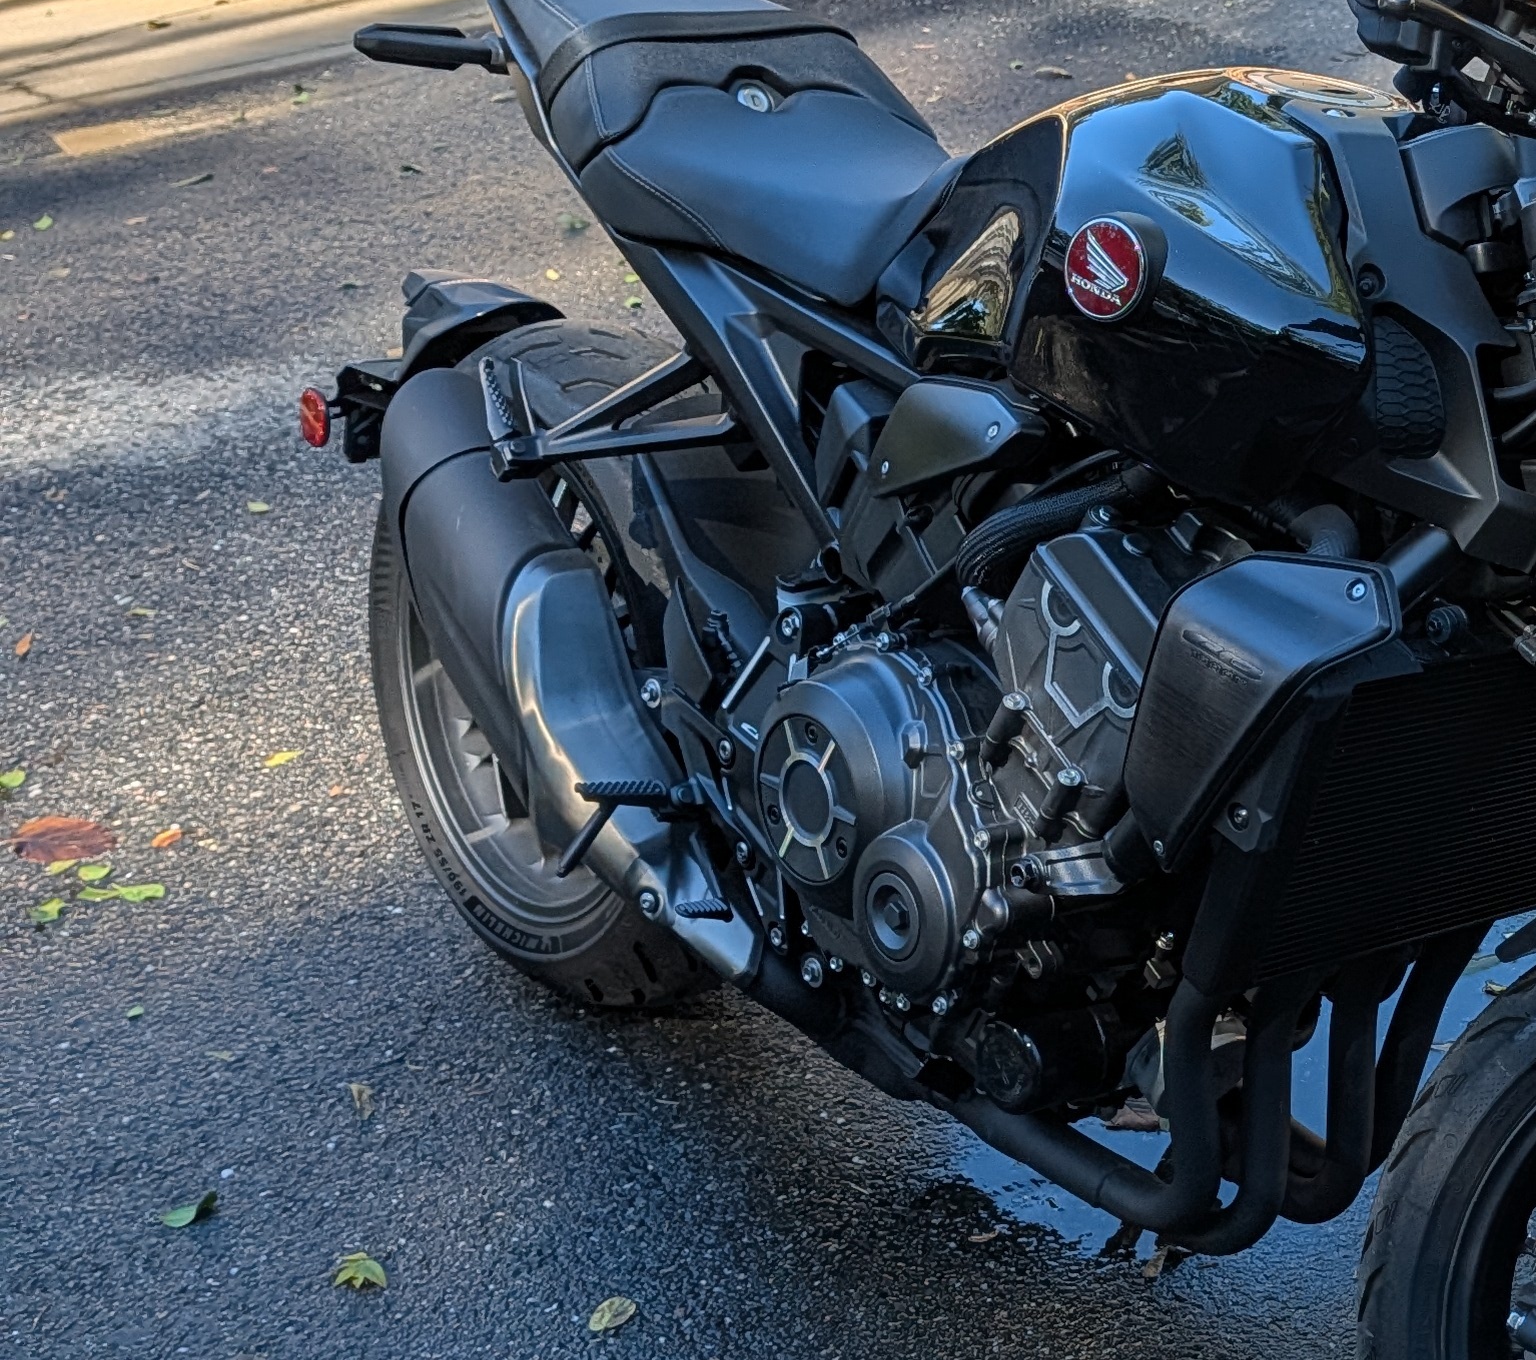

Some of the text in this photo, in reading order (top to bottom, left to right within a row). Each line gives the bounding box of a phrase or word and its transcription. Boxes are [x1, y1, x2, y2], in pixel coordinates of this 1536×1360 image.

[1070, 272, 1122, 307] HONDA
[433, 848, 467, 898] 190/55
[473, 904, 539, 950] MICHELIN
